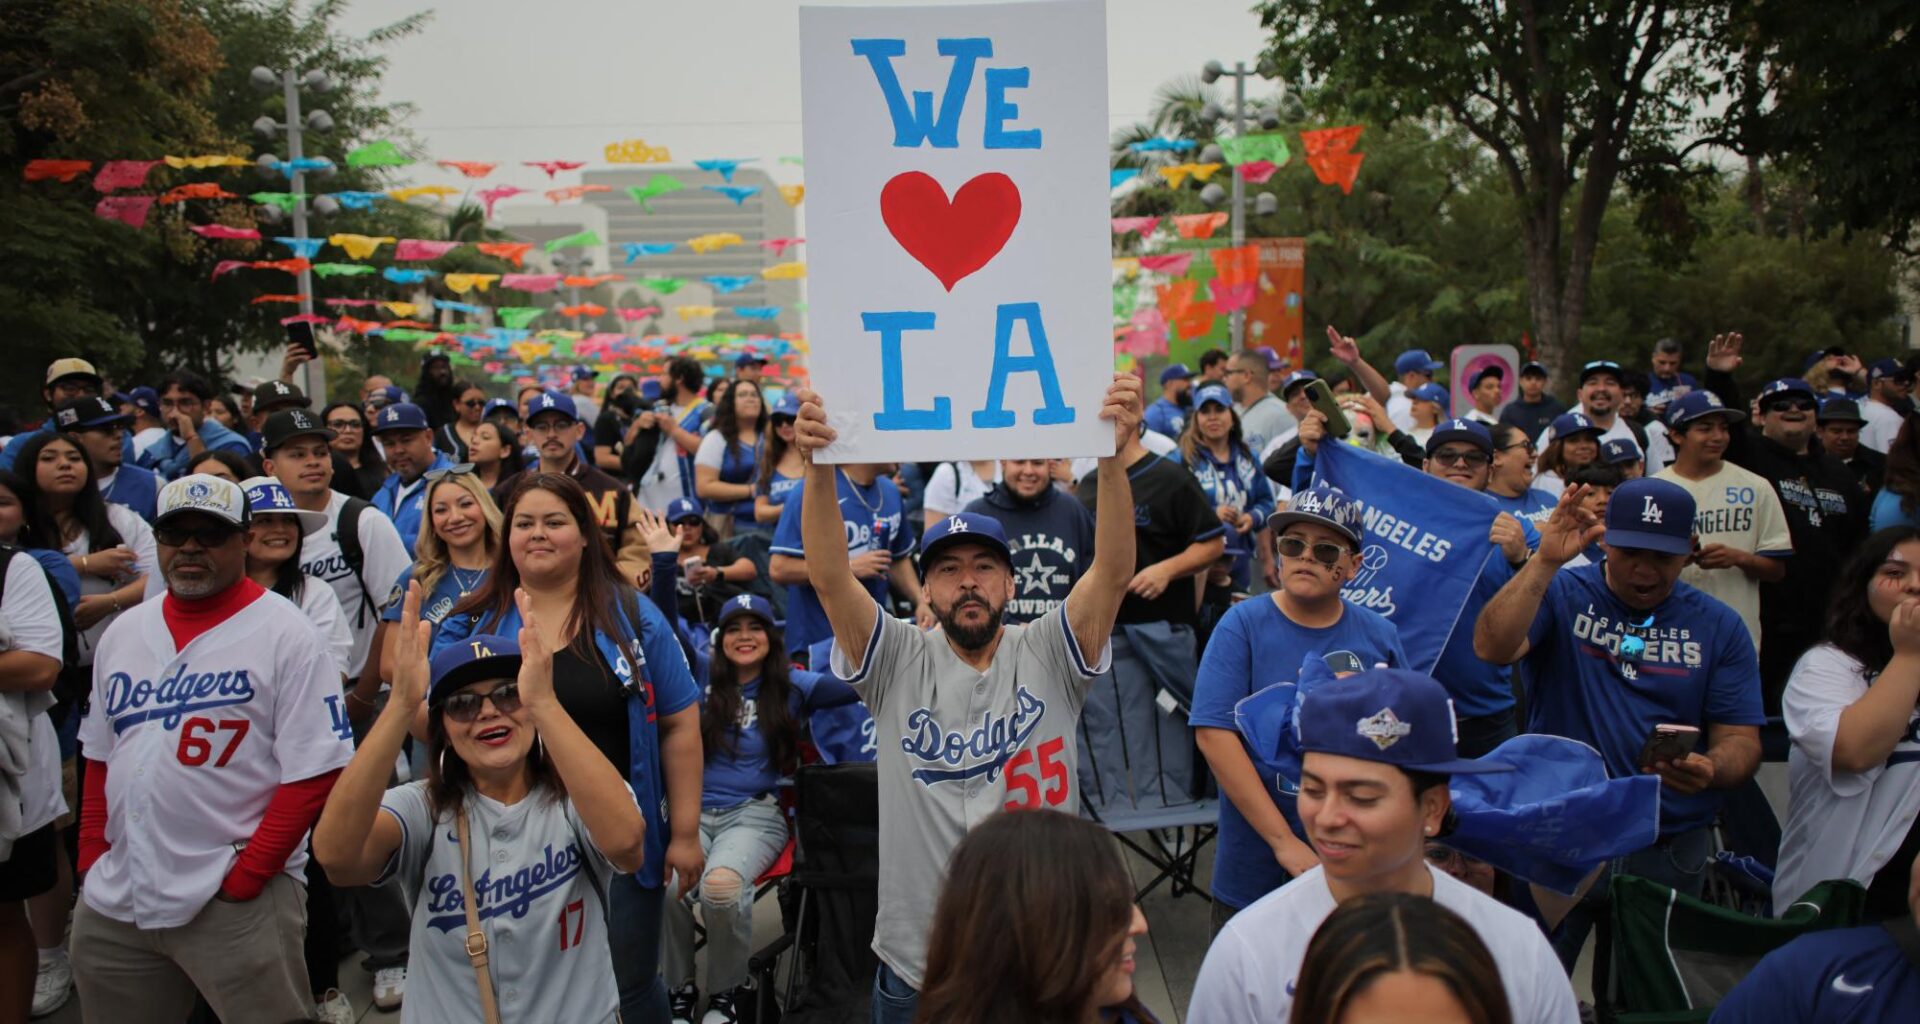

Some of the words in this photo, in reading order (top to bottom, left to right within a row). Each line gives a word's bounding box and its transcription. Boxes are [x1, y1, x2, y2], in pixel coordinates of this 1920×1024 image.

[850, 37, 1042, 150] WE
[861, 301, 1076, 431] LA
[273, 380, 290, 395] LA
[541, 392, 555, 408] LA
[386, 407, 399, 422] LA
[1453, 419, 1467, 430] LA
[271, 485, 293, 508] LA
[1303, 490, 1322, 514] LA
[1725, 487, 1754, 505] 50
[1641, 495, 1662, 524] LA
[948, 515, 968, 533] LA
[106, 664, 254, 732] Dodgers
[323, 694, 353, 741] LA
[176, 716, 251, 768] 67
[1003, 736, 1069, 814] 55
[557, 898, 586, 952] 17
